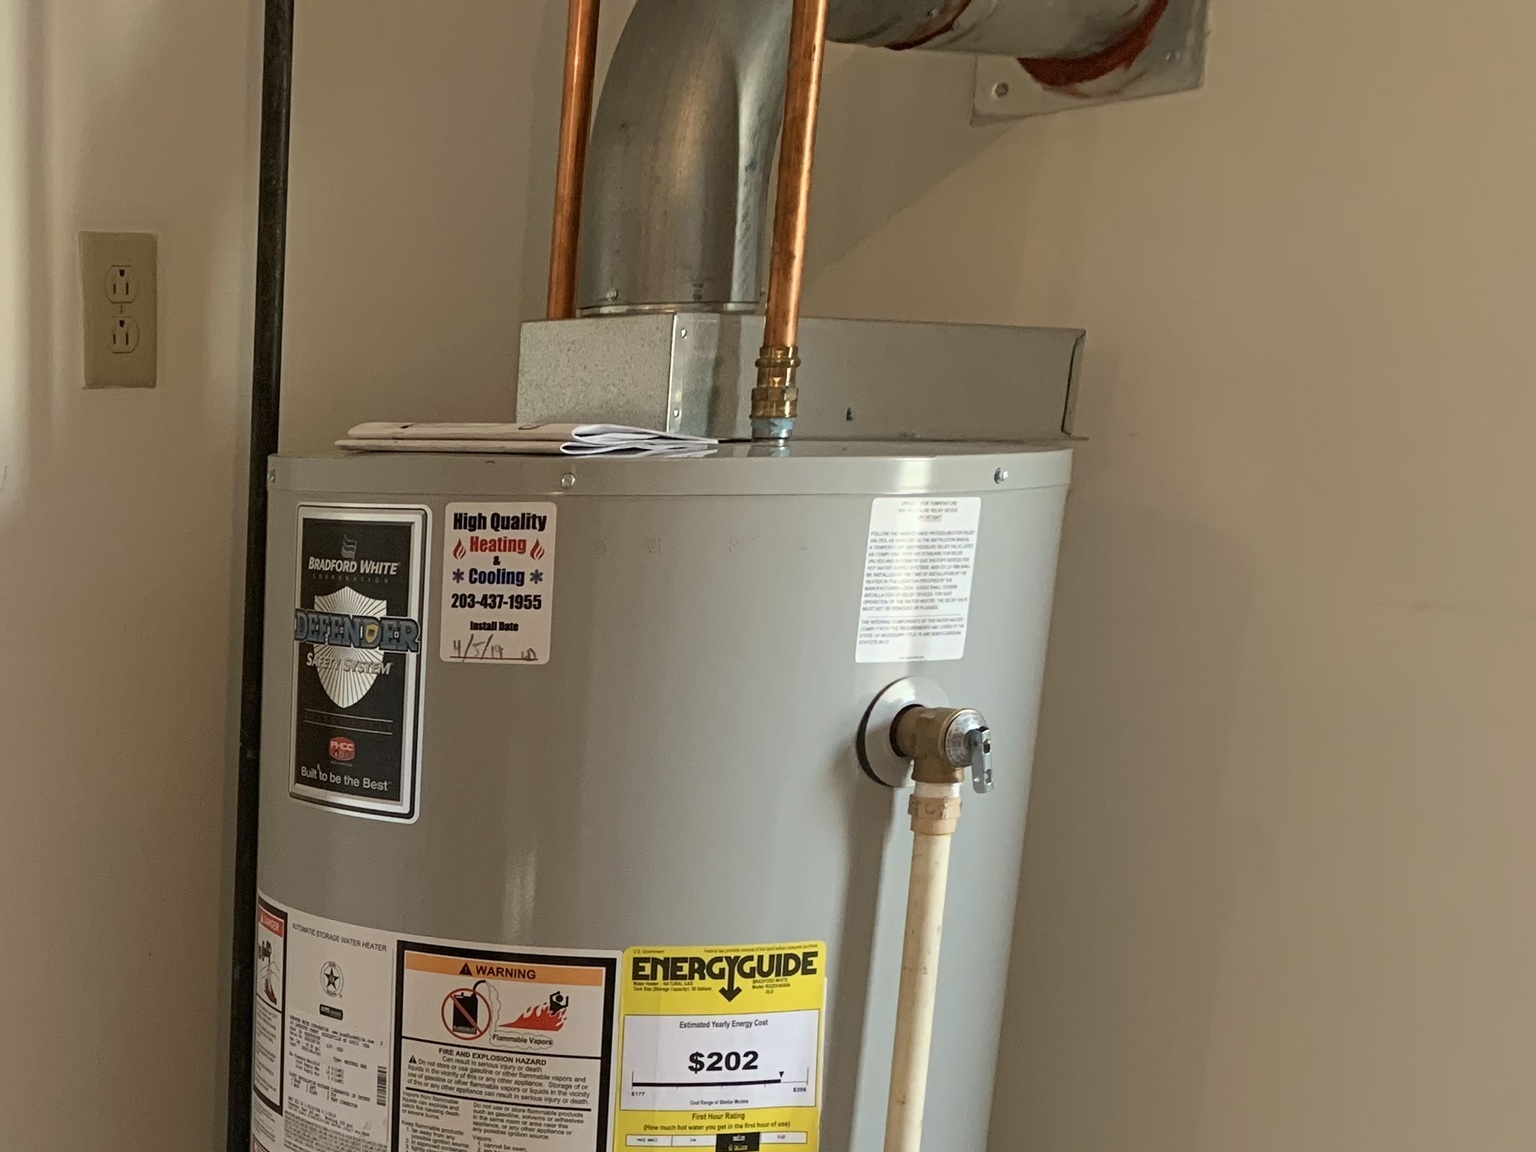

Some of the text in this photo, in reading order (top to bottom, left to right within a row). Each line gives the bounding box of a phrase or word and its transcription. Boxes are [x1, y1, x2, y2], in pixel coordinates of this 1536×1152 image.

[453, 513, 547, 532] High Quality
[470, 536, 526, 554] Heating
[308, 557, 397, 575] BRADFORD WHITE
[493, 556, 500, 565] &
[469, 568, 525, 586] Cooling
[451, 594, 541, 609] 203-437-1955
[295, 610, 419, 652] DEFENDER
[470, 621, 518, 631] Install Date
[306, 653, 392, 674] SAFETY SYSTEM
[301, 766, 388, 791] Built to be the Best
[292, 923, 386, 952] AUTOMATIC STORAGE WATER HEATER
[476, 965, 536, 979] WARNING
[632, 951, 818, 984] ENERGYGUIDE
[679, 1021, 709, 1029] Estimated
[712, 1020, 730, 1029] Yearly
[732, 1020, 752, 1028] Energy
[493, 1034, 552, 1046] Flammable Vapors
[438, 1047, 546, 1065] FIRE AND EXPLOSION HAZARD
[688, 1051, 758, 1074] $202
[724, 1112, 745, 1120] Rating
